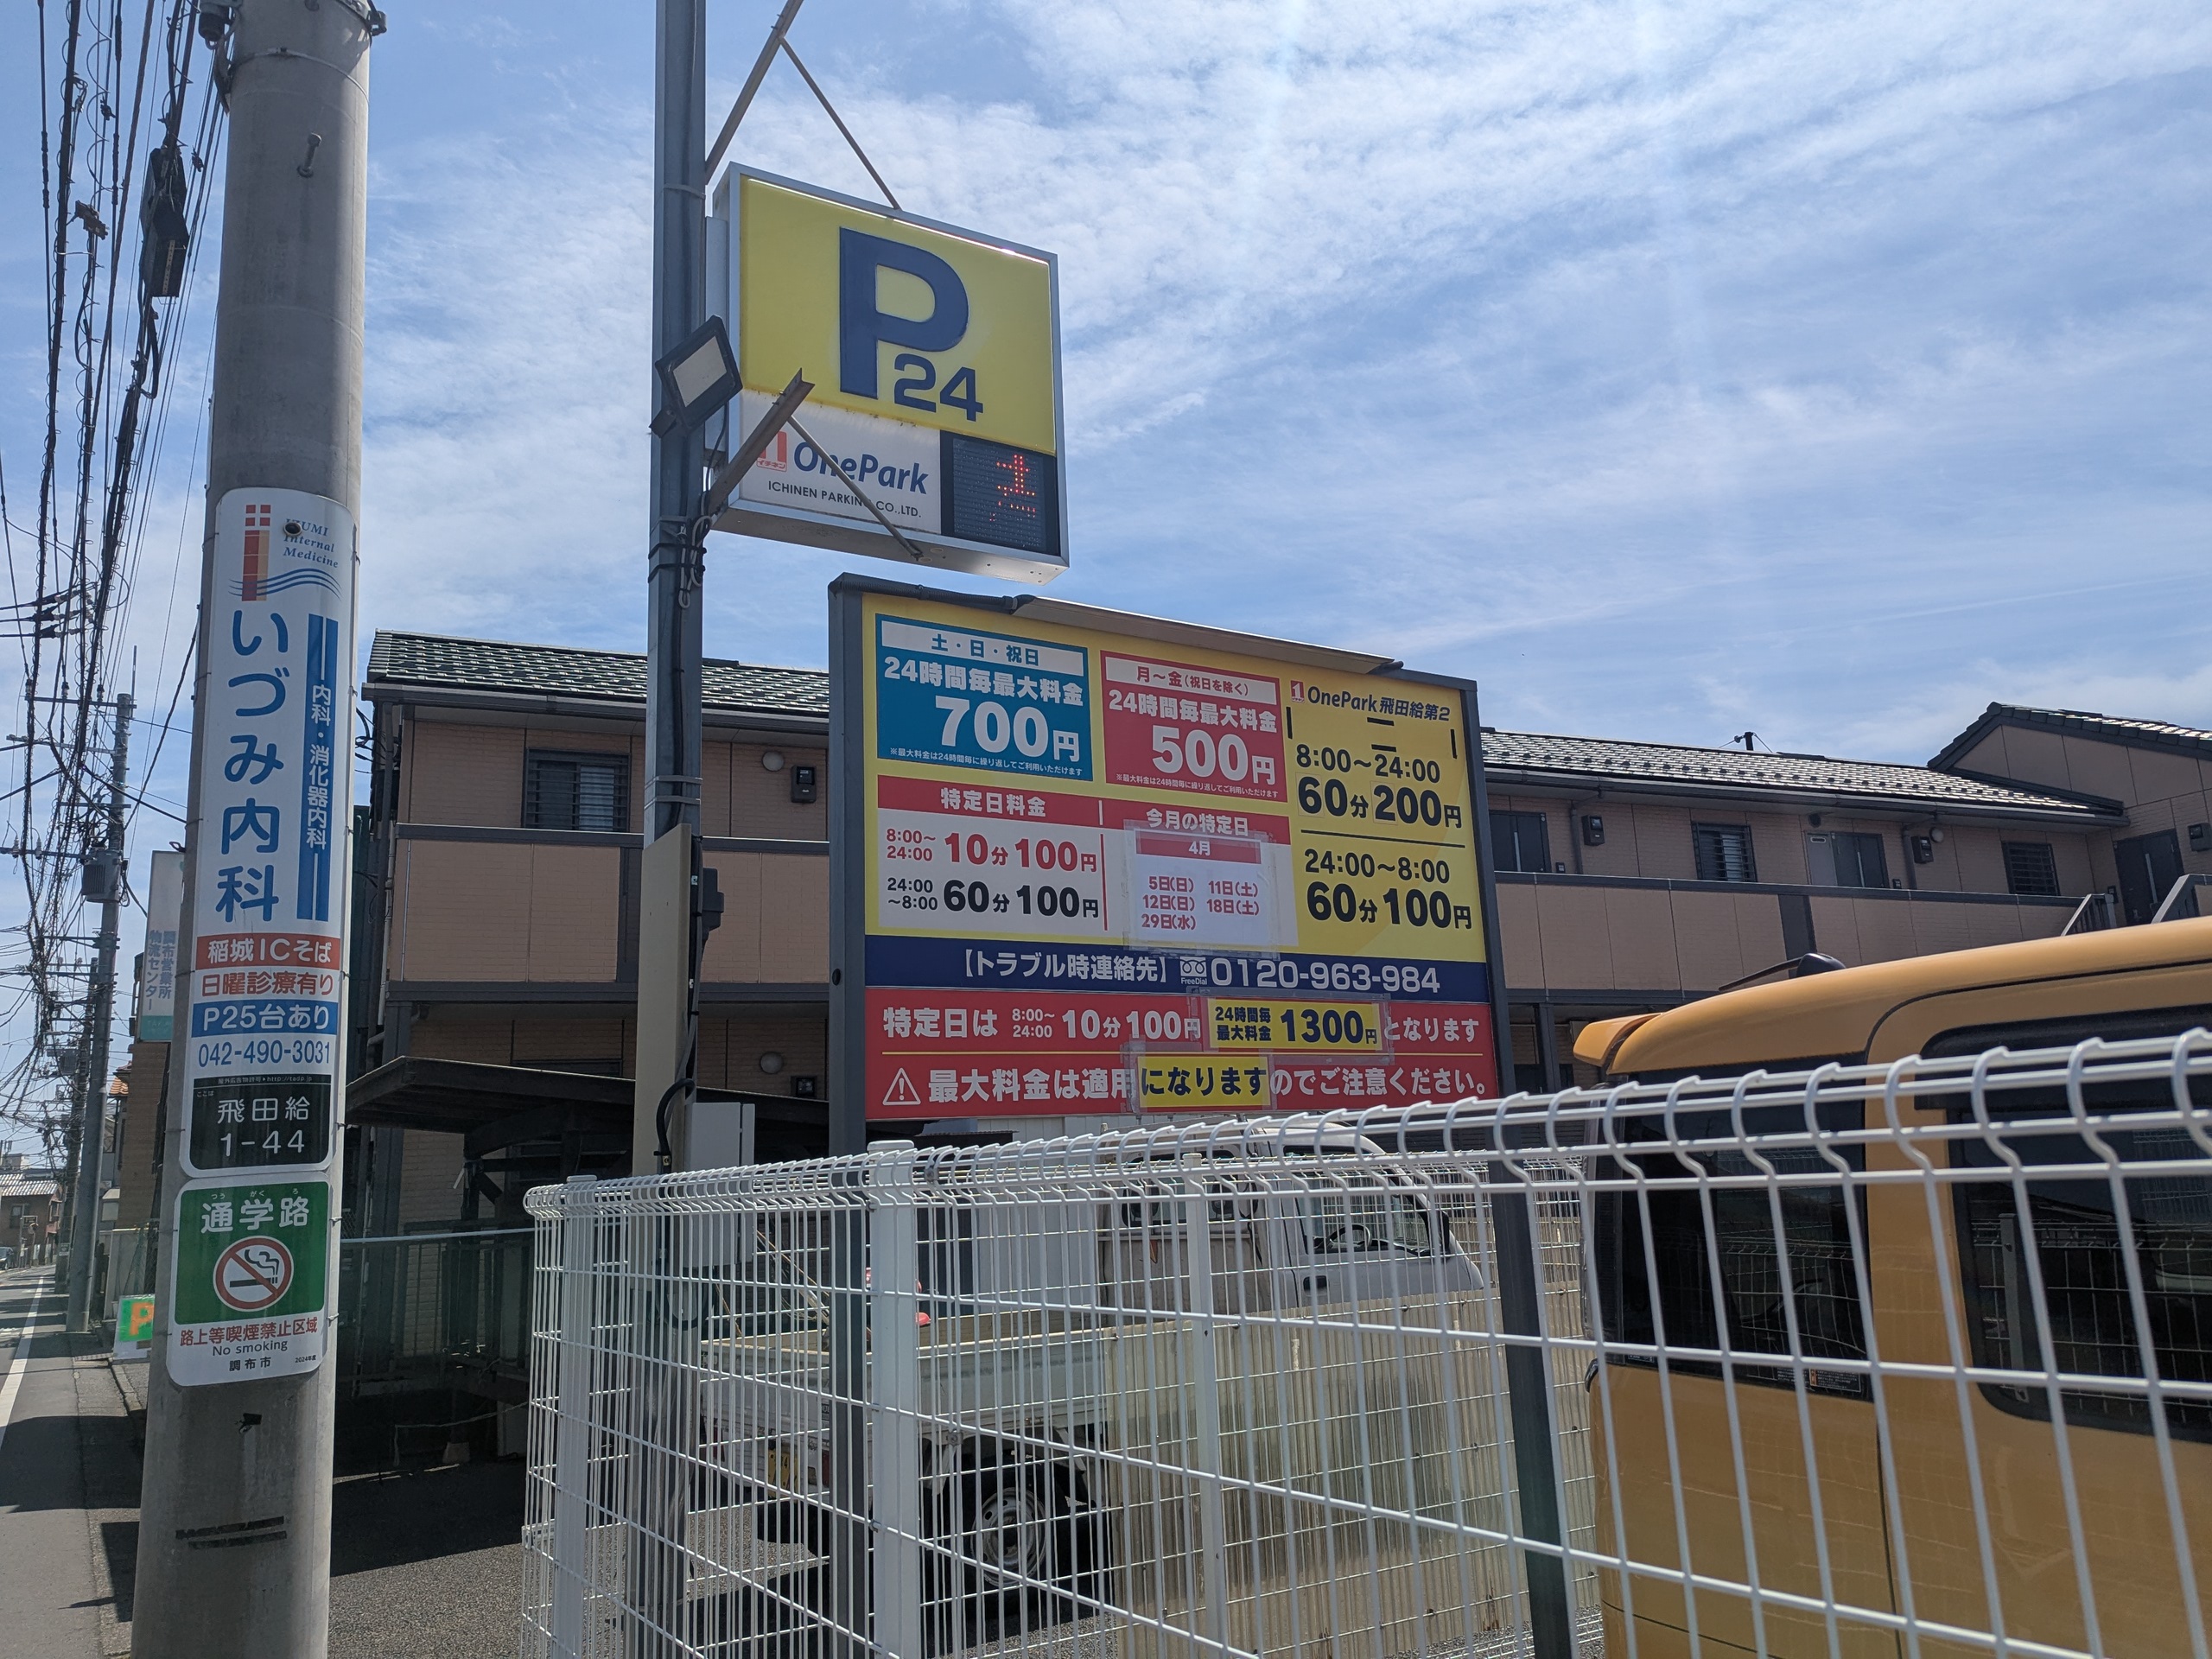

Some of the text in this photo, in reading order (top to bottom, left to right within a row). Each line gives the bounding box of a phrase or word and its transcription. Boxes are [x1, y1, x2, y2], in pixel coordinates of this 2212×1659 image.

[839, 226, 984, 422] P 24
[793, 442, 929, 495] OnePark
[768, 480, 922, 518] ICHINEN PARKIN CO.,LTD.
[286, 518, 328, 537] UMI
[283, 535, 334, 553] Internal
[283, 547, 339, 569] Medicine
[931, 633, 1040, 667] 土・日・祝日
[884, 656, 1084, 707] 24時間毎最大料金
[1109, 690, 1278, 734] 24時間毎最大料金
[1307, 685, 1377, 713] OnePark
[935, 695, 1080, 762] 700円
[215, 609, 290, 923] いづみ内科
[306, 683, 332, 850] 内科・消化器内科
[1152, 725, 1276, 785] 500円
[940, 787, 1046, 817] 特定日料金
[1298, 776, 1462, 829] 60分 200円
[1146, 808, 1249, 836] 今月の特定日
[887, 845, 933, 862] 24:00
[944, 832, 1097, 873] 10分 100円
[1188, 840, 1211, 856] 4月
[887, 877, 933, 893] 24:00
[944, 879, 1099, 918] 60分 100円
[1306, 880, 1472, 930] 60分 100円
[207, 938, 332, 964] 稲城ICそば
[201, 970, 334, 997] 日曜診療有り
[1211, 957, 1440, 993] 0120-963-984
[203, 1003, 329, 1031] P25台あり
[882, 1007, 999, 1039] 特定日は
[1215, 1007, 1272, 1023] 24時間毎
[1280, 1008, 1378, 1045] 1300円
[1384, 1017, 1479, 1043] となります
[1013, 1025, 1053, 1038] 24:00
[1217, 1025, 1273, 1042] 最大料金
[198, 1039, 330, 1067] 042-490-3031
[1141, 1066, 1267, 1096] になります
[1270, 1065, 1485, 1097] のでご注意ください。
[217, 1096, 310, 1124] 飛田給
[200, 1196, 309, 1234] 通学路
[130, 1302, 155, 1336] P
[180, 1316, 318, 1347] 路上等喫煙禁止区域
[213, 1340, 289, 1356] No smoking
[295, 1354, 317, 1363] 2024年度
[229, 1356, 271, 1371] 調布市
